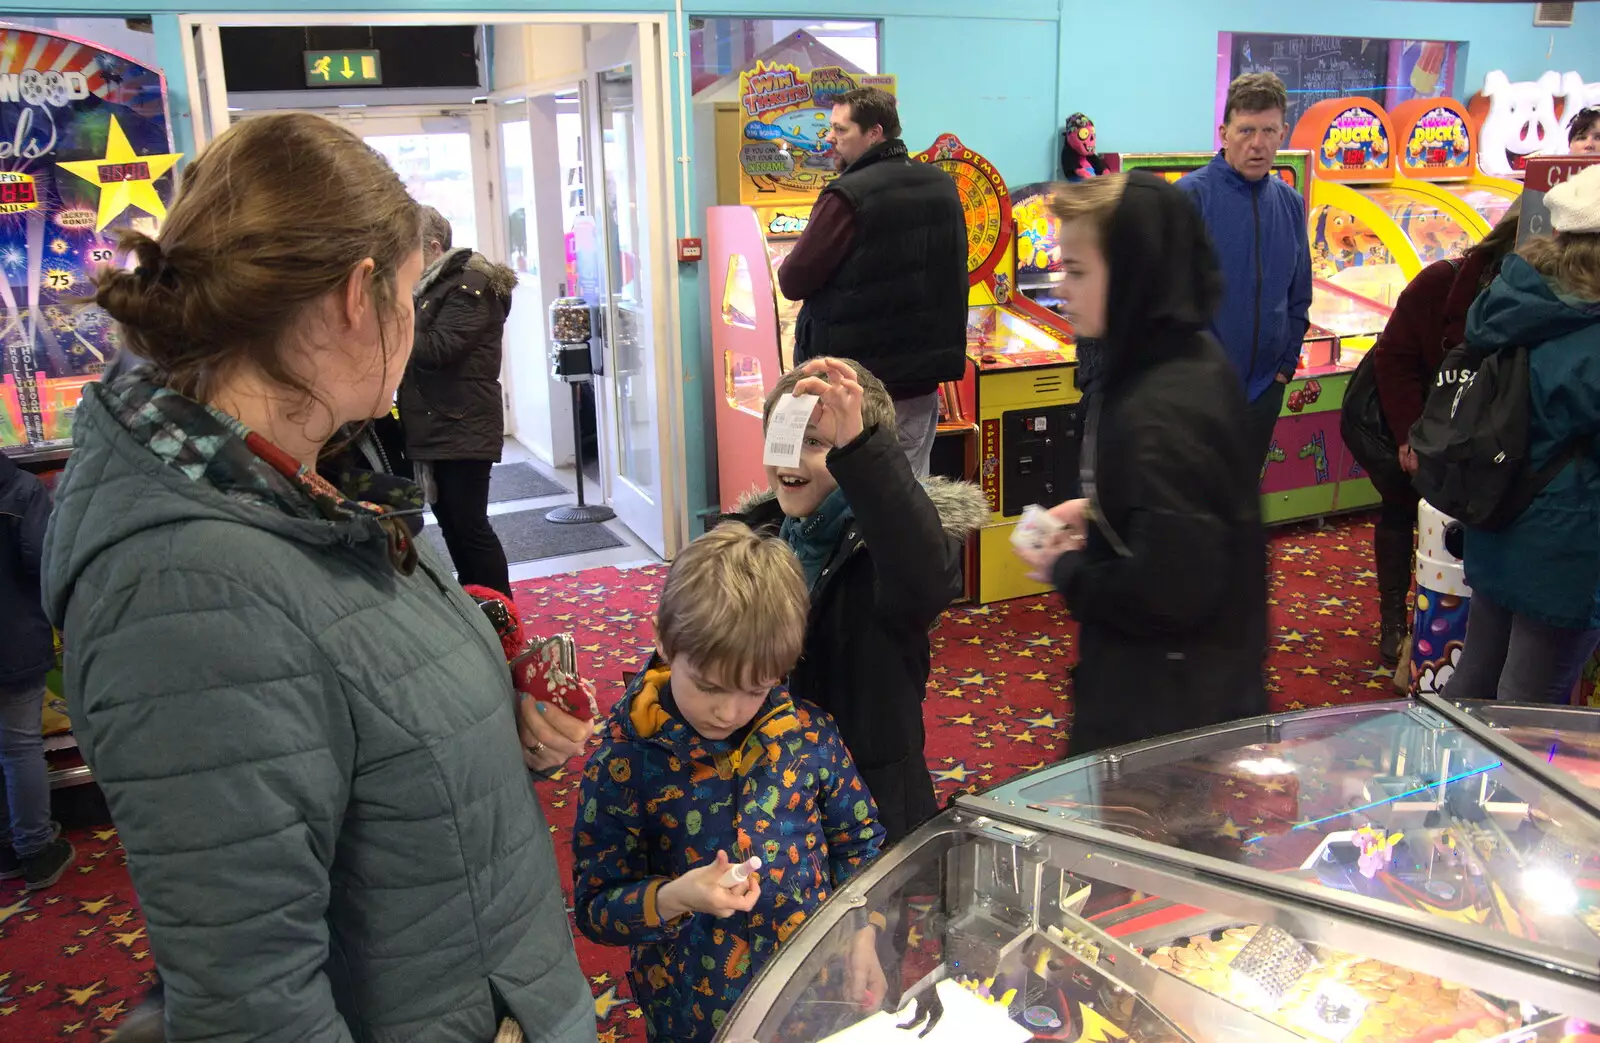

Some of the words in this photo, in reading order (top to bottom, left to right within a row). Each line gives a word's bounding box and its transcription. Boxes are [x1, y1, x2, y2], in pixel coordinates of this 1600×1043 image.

[752, 75, 792, 94] WIN
[861, 76, 892, 85] namco
[1337, 117, 1373, 128] LUCKY
[1422, 117, 1456, 128] LUCKY
[1330, 126, 1380, 144] DUCKS
[1415, 126, 1462, 144] DUCKS
[963, 150, 1007, 197] DEMON
[62, 217, 94, 225] BONUS
[93, 250, 112, 261] 50
[50, 275, 69, 286] 75
[986, 424, 995, 459] SPEED
[986, 474, 997, 507] DEMON
